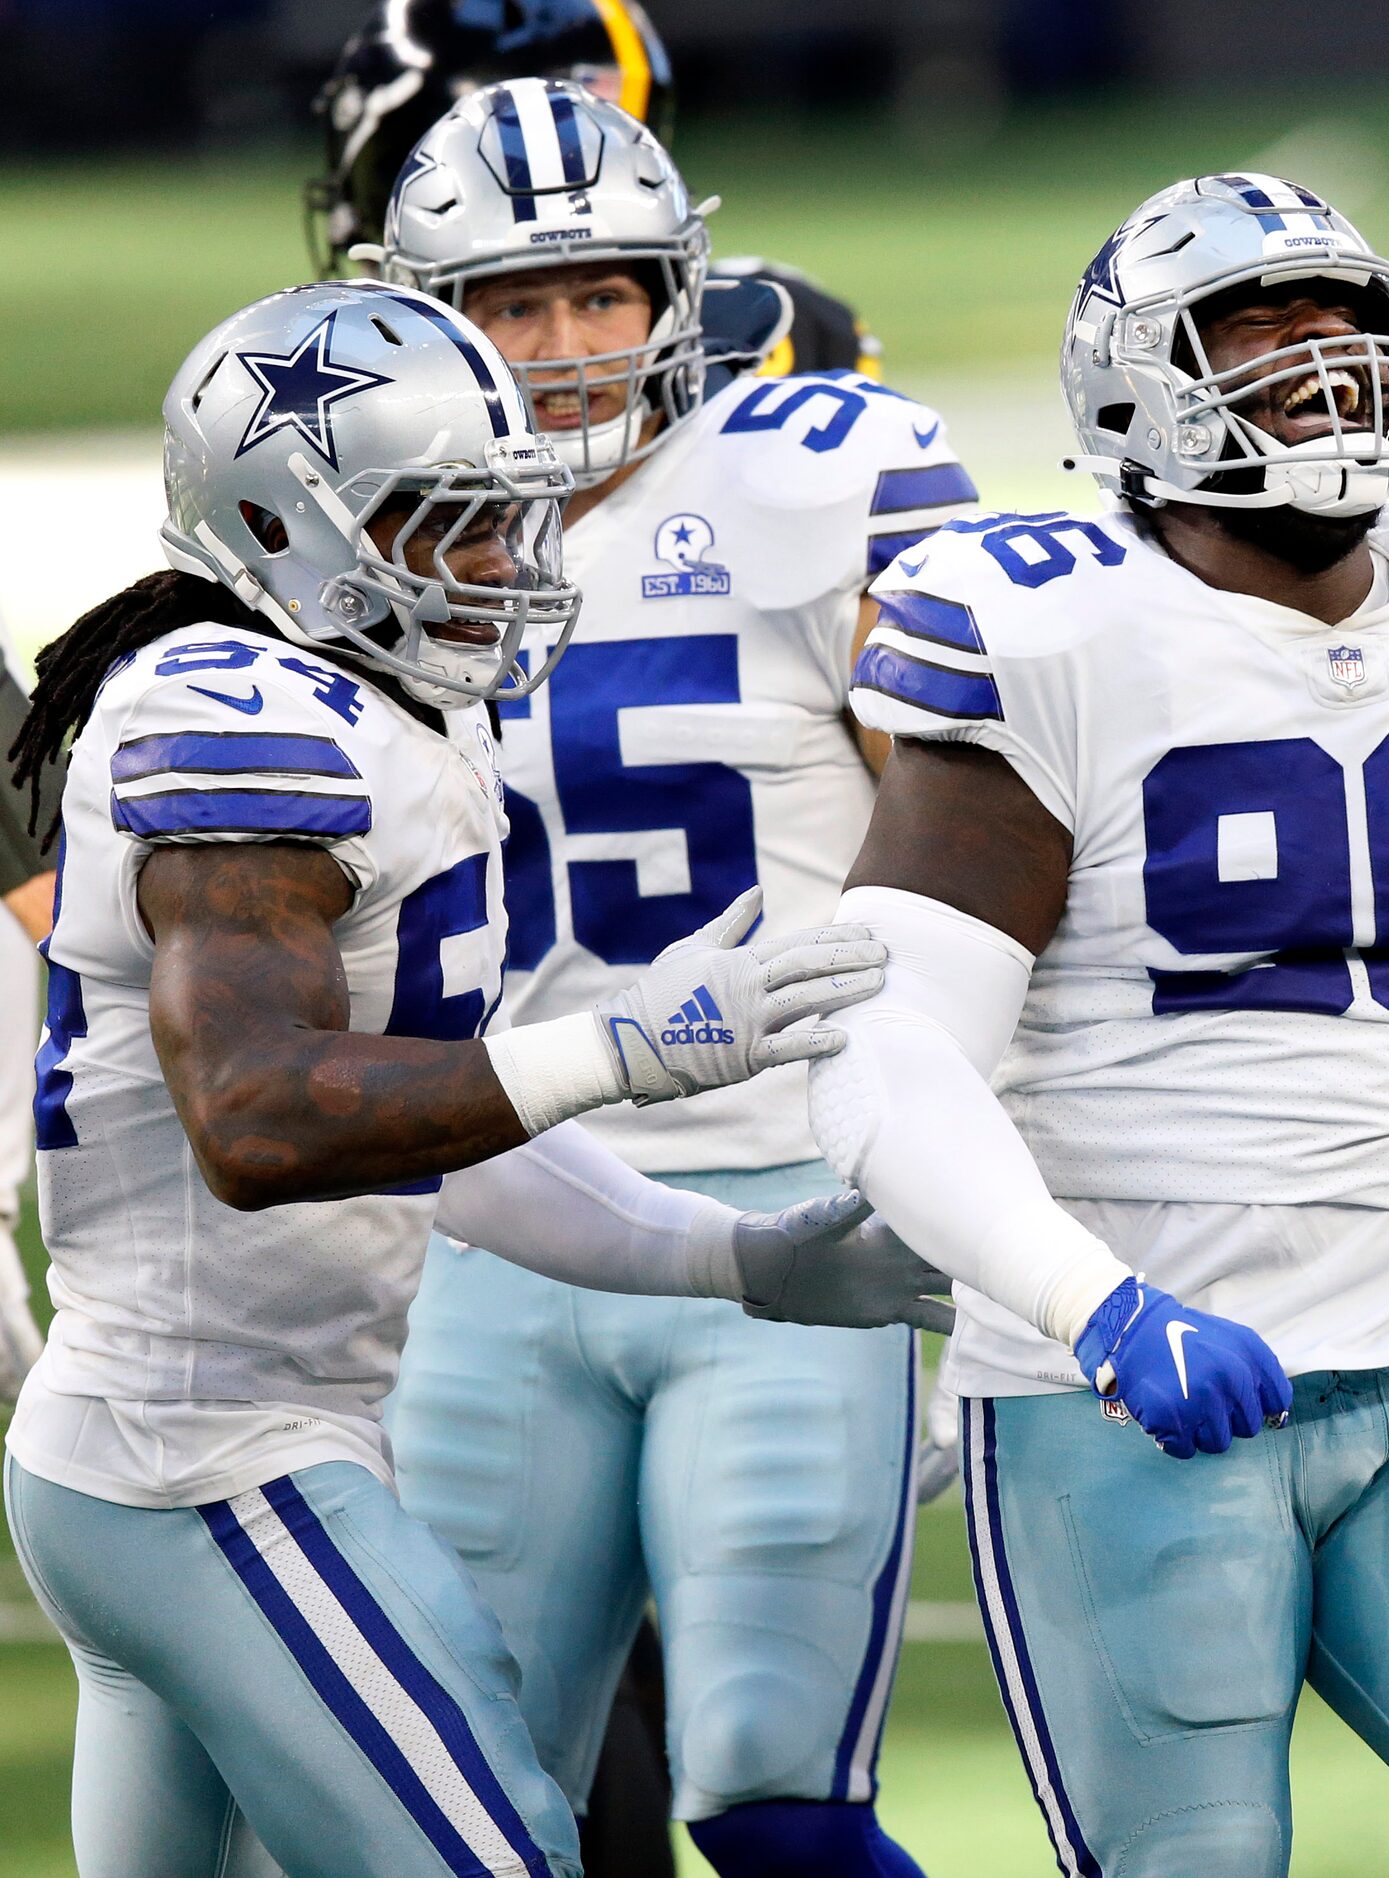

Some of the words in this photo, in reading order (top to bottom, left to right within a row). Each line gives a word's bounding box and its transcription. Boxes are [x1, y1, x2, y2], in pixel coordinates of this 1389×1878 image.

[1284, 237, 1337, 248] COWBOY
[644, 576, 684, 596] EST.
[1334, 661, 1362, 679] NFL
[155, 640, 365, 728] 54
[660, 1022, 735, 1046] adidas
[1036, 1370, 1077, 1382] DRI-FIT
